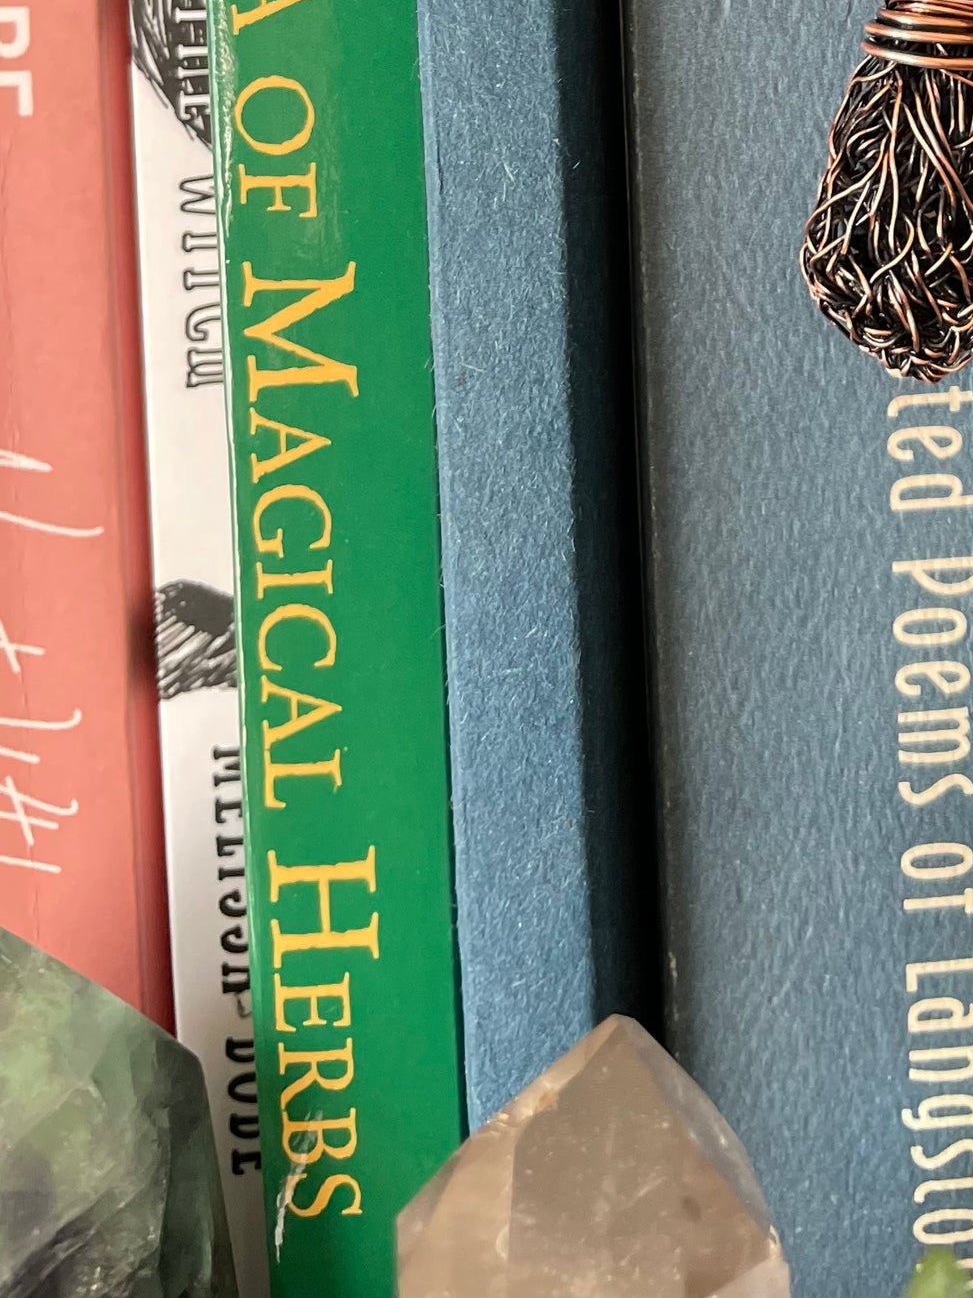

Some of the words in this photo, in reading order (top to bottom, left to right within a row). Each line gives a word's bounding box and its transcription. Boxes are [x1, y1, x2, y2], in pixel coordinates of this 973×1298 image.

[234, 75, 317, 218] OF
[243, 260, 359, 809] MAGICAL
[267, 844, 380, 1218] HERBS
